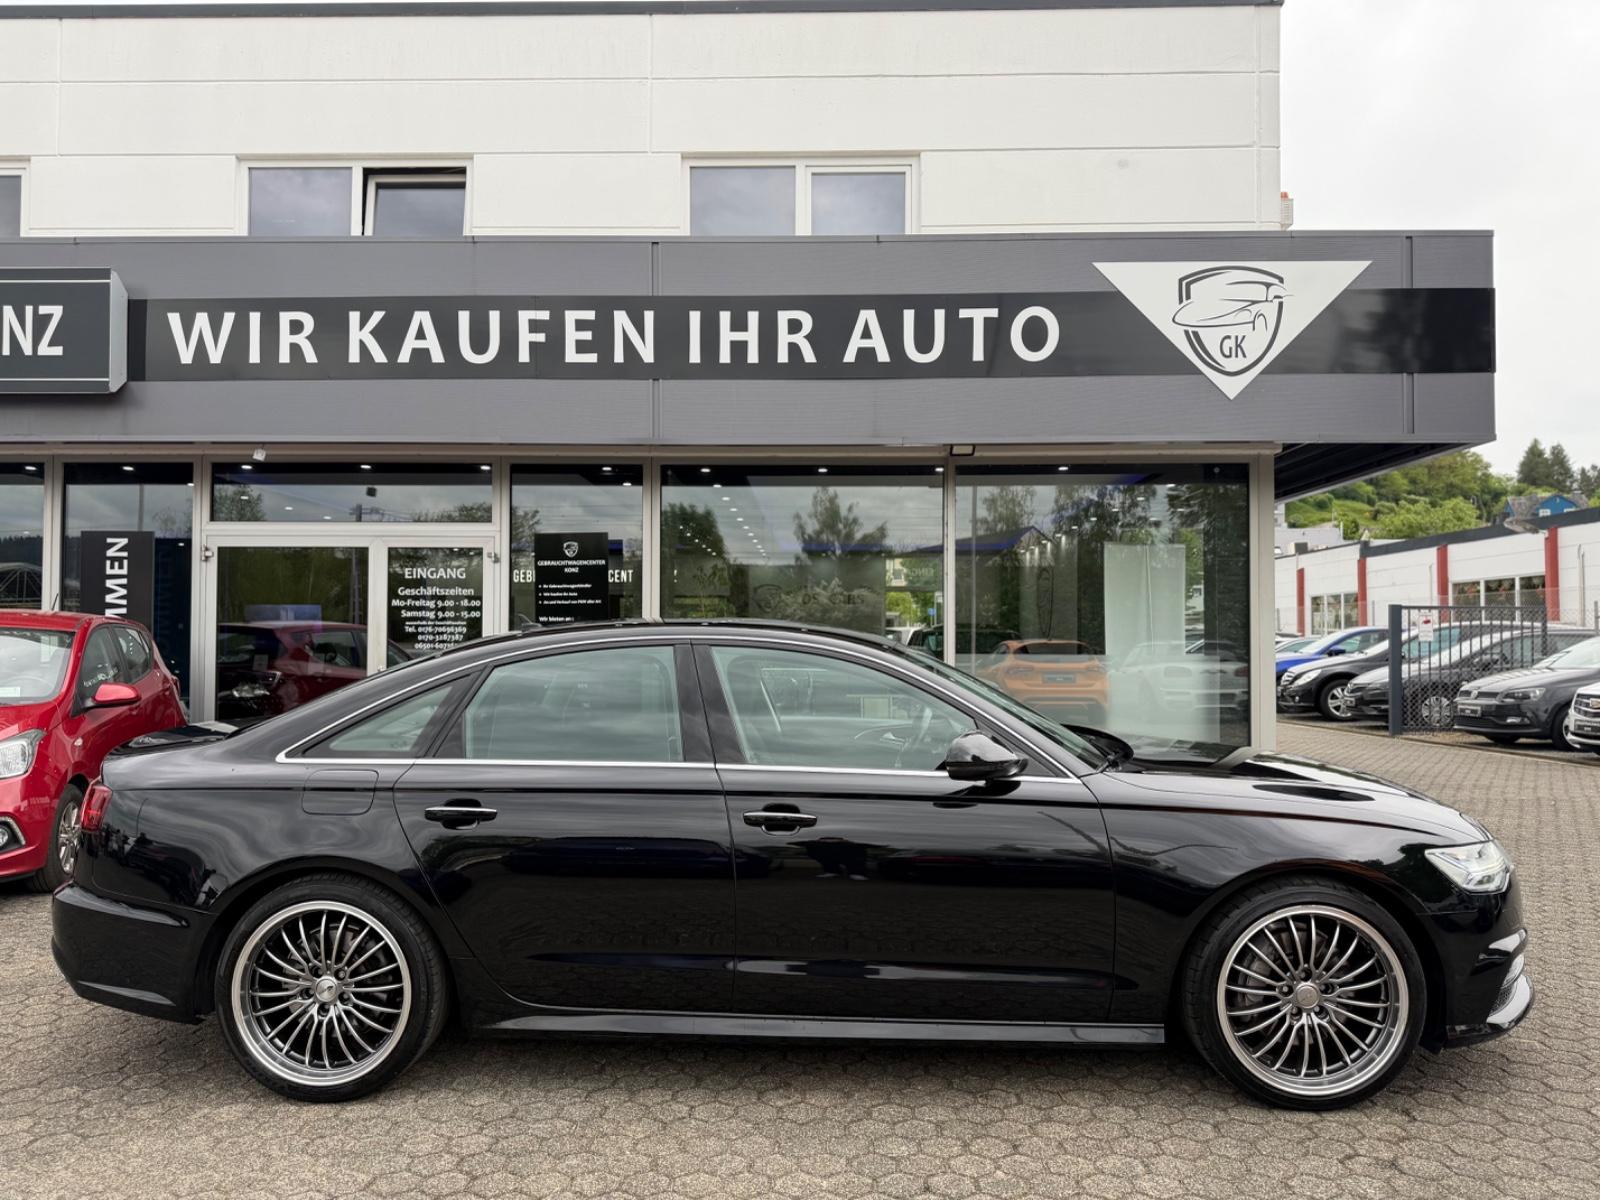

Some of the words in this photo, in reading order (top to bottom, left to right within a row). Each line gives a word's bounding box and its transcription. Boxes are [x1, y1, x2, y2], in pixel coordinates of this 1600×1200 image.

[2, 305, 63, 356] NZ
[167, 311, 318, 364] WIR
[348, 309, 655, 364] KAUFEN
[688, 310, 817, 364] IHR
[842, 306, 1060, 364] AUTO
[1219, 335, 1247, 359] GK
[404, 567, 466, 579] EINGANG
[513, 569, 536, 583] GEB
[397, 586, 475, 596] Geschäftszeiten
[391, 599, 435, 609] Mo-Freitag
[437, 600, 455, 608] 9.00
[461, 599, 481, 607] 18.00
[401, 610, 435, 619] Samstag
[437, 611, 455, 619] 9.00
[461, 611, 481, 619] 15.00
